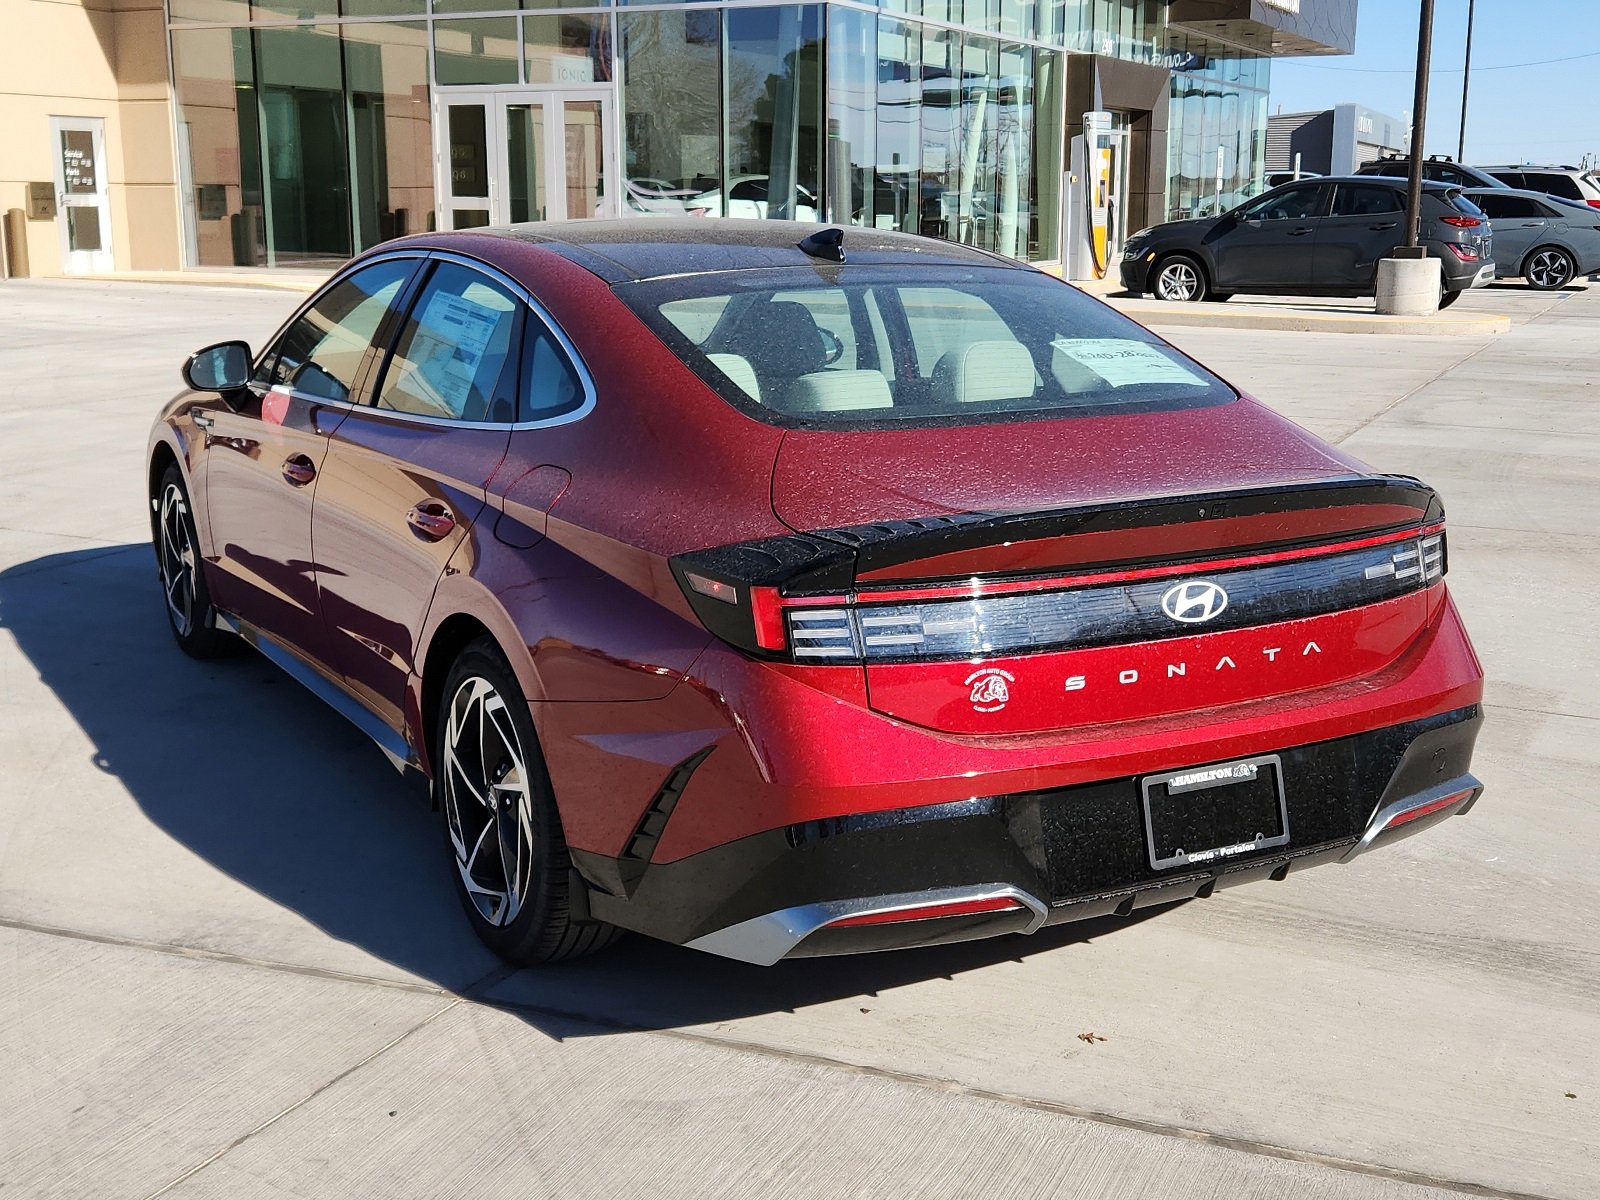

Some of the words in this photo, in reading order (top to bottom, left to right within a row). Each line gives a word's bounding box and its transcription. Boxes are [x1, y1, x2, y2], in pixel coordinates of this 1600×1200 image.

[1065, 641, 1322, 690] SONATA
[1174, 767, 1233, 786] HAMILTON
[1188, 850, 1215, 863] Clovis
[1220, 843, 1256, 857] Portales
